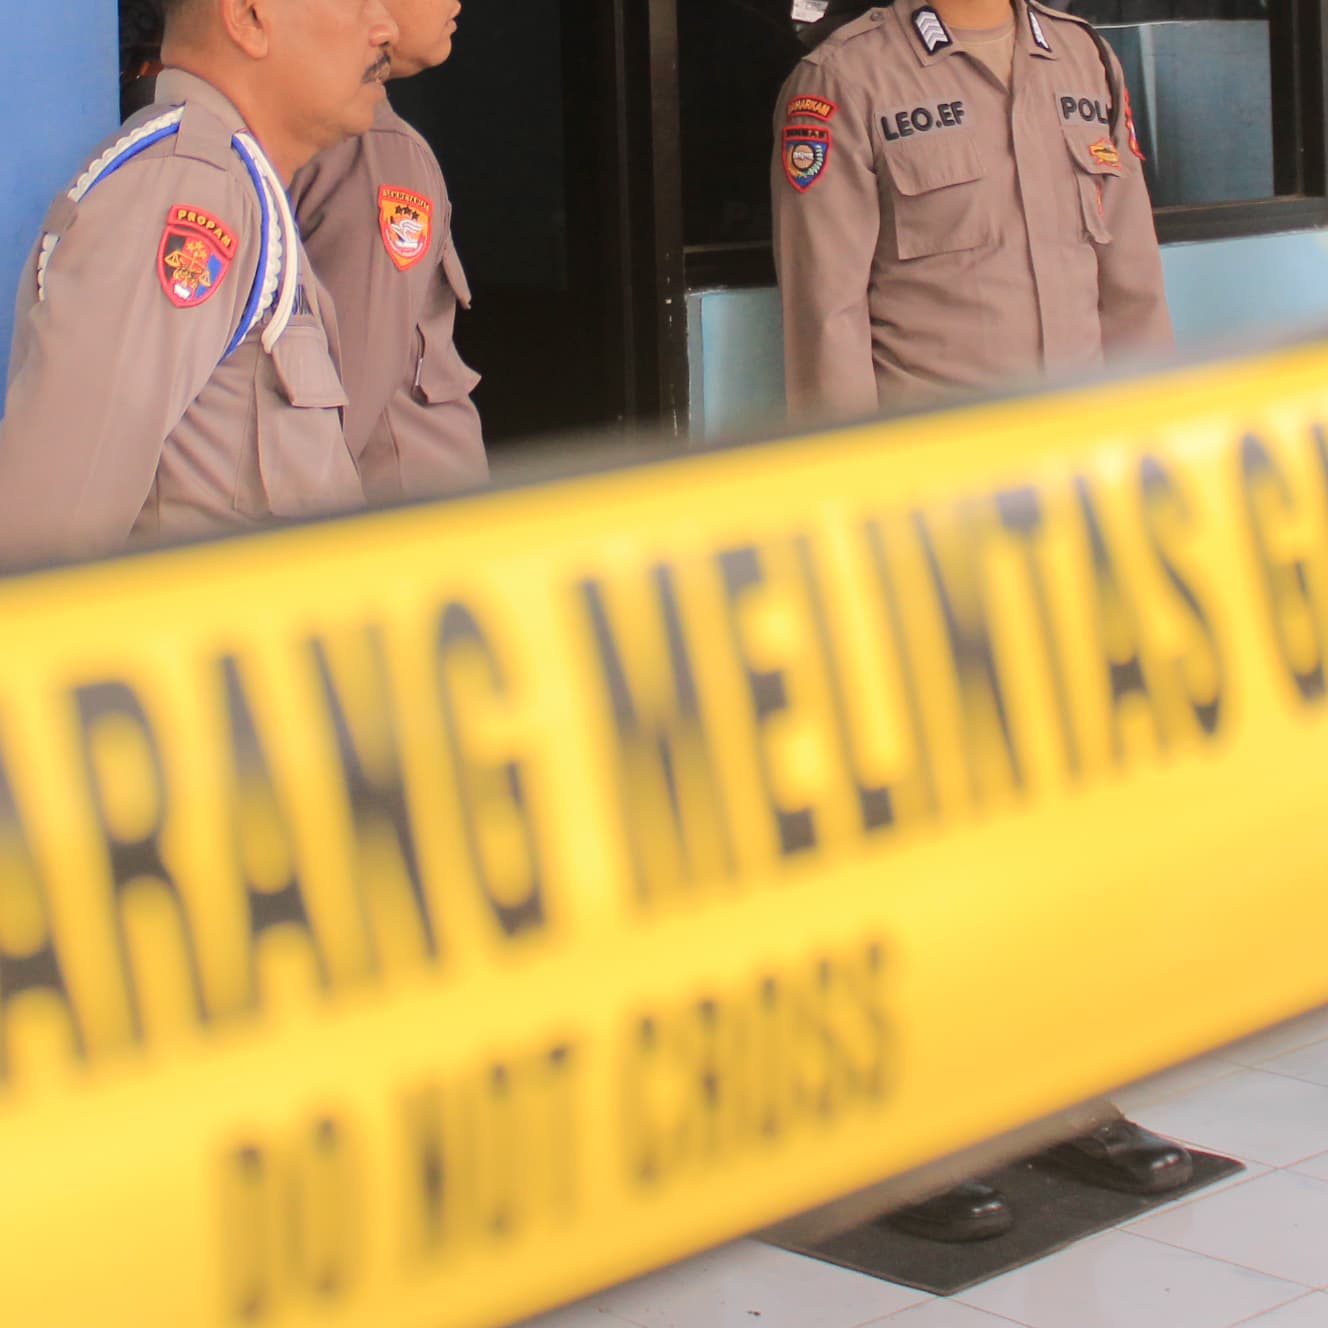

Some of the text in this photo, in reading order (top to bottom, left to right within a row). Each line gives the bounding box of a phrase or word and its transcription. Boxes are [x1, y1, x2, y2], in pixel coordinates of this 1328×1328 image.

[881, 100, 964, 141] LEO.EF
[177, 209, 232, 247] PROPAM
[580, 454, 1224, 904] MELINTAS
